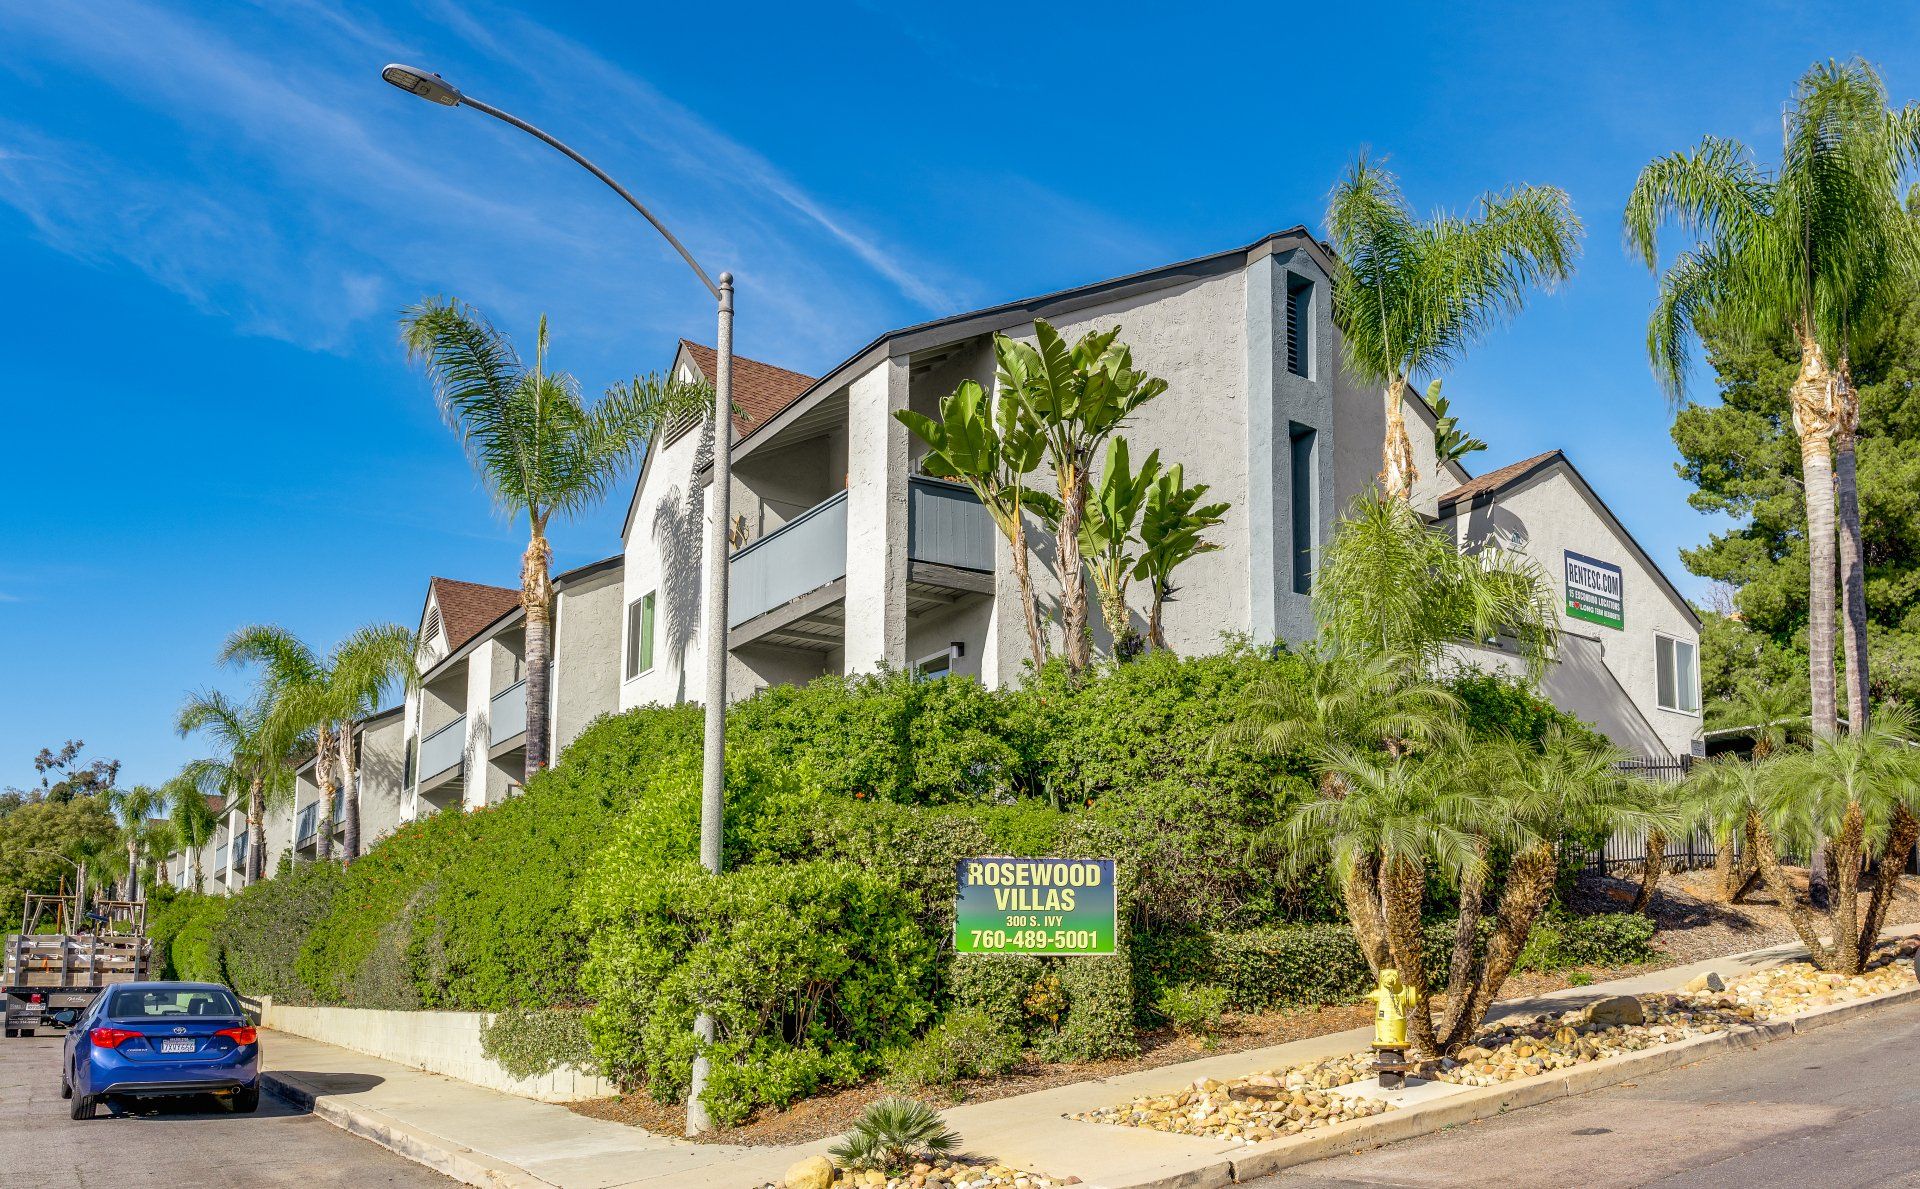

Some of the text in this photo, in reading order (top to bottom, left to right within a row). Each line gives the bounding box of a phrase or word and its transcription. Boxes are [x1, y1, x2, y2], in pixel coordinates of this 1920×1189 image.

[1569, 563, 1618, 596] RENTESC.COM
[1569, 589, 1574, 598] 15
[967, 862, 1101, 887] ROSEWOOD
[994, 888, 1076, 912] VILLAS
[1006, 915, 1063, 927] 300 S. IVY
[971, 930, 1098, 949] 760-489-5001
